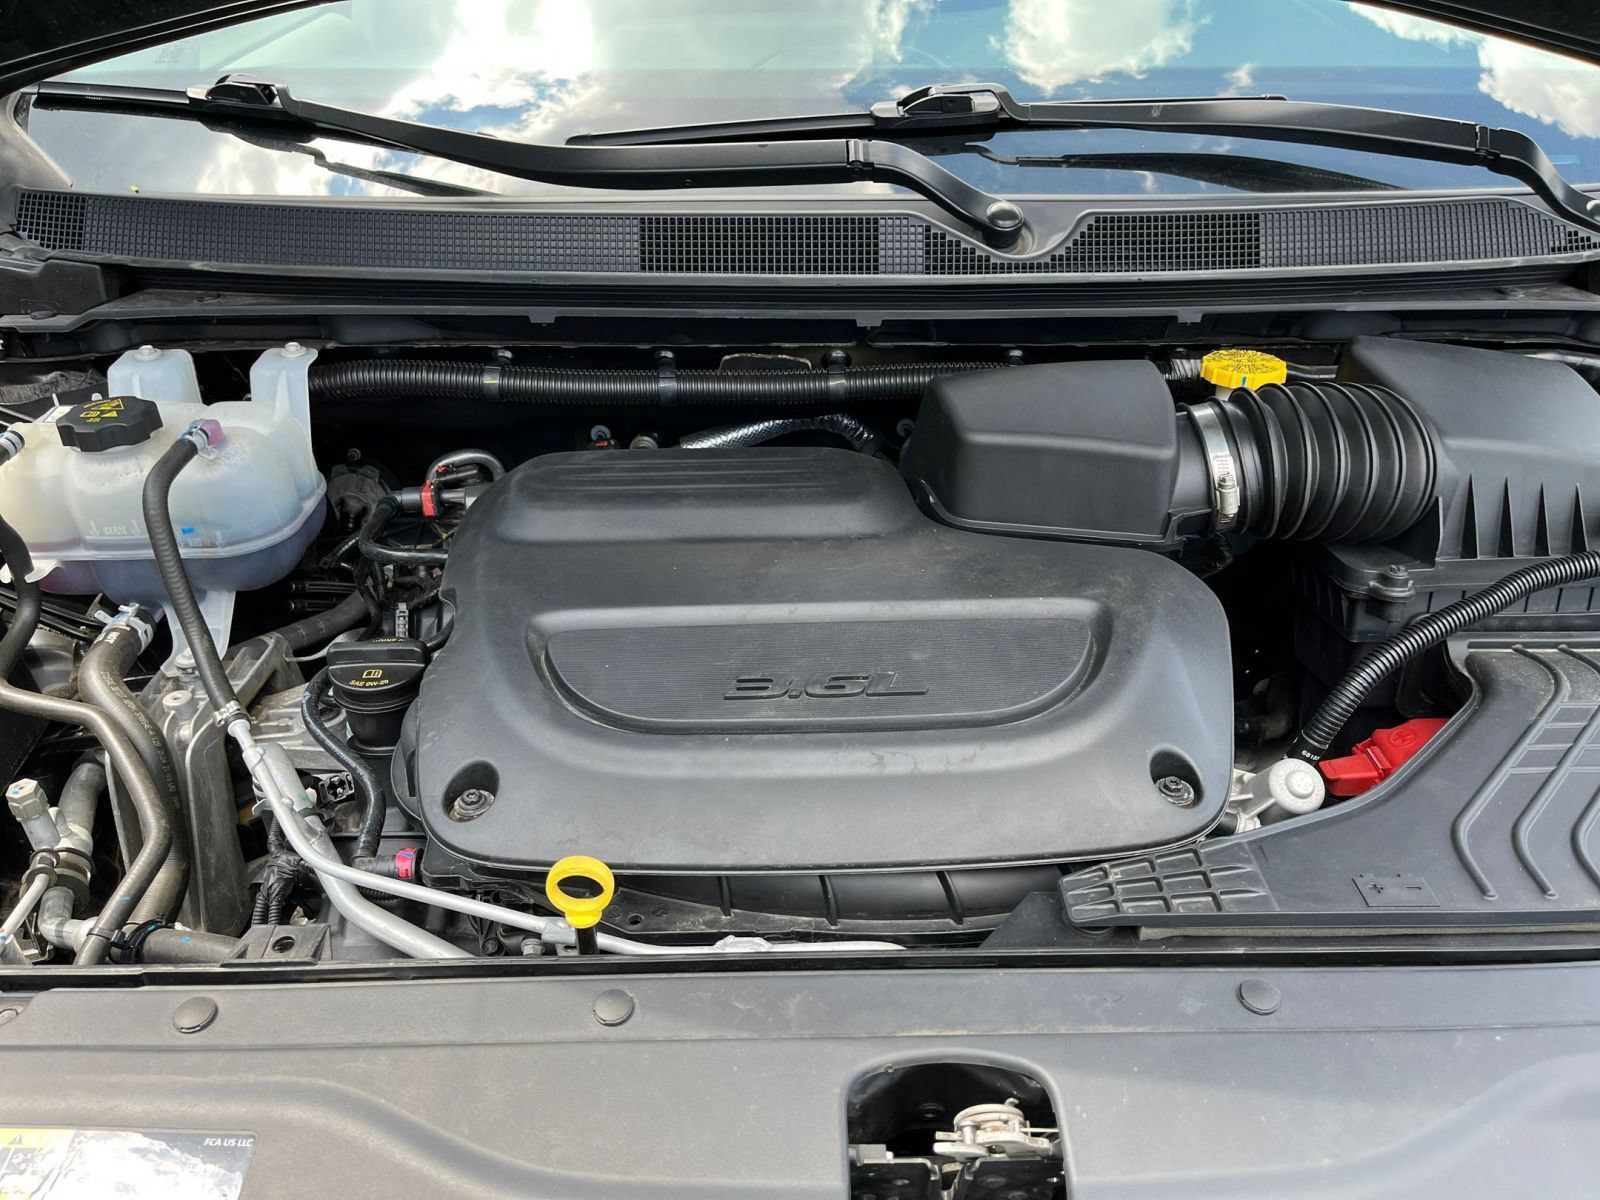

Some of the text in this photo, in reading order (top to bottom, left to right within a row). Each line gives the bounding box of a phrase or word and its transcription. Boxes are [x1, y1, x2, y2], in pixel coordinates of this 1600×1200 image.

[349, 679, 365, 687] SAE
[723, 671, 929, 700] 3.6L
[204, 1138, 254, 1147] FCA US LLC
